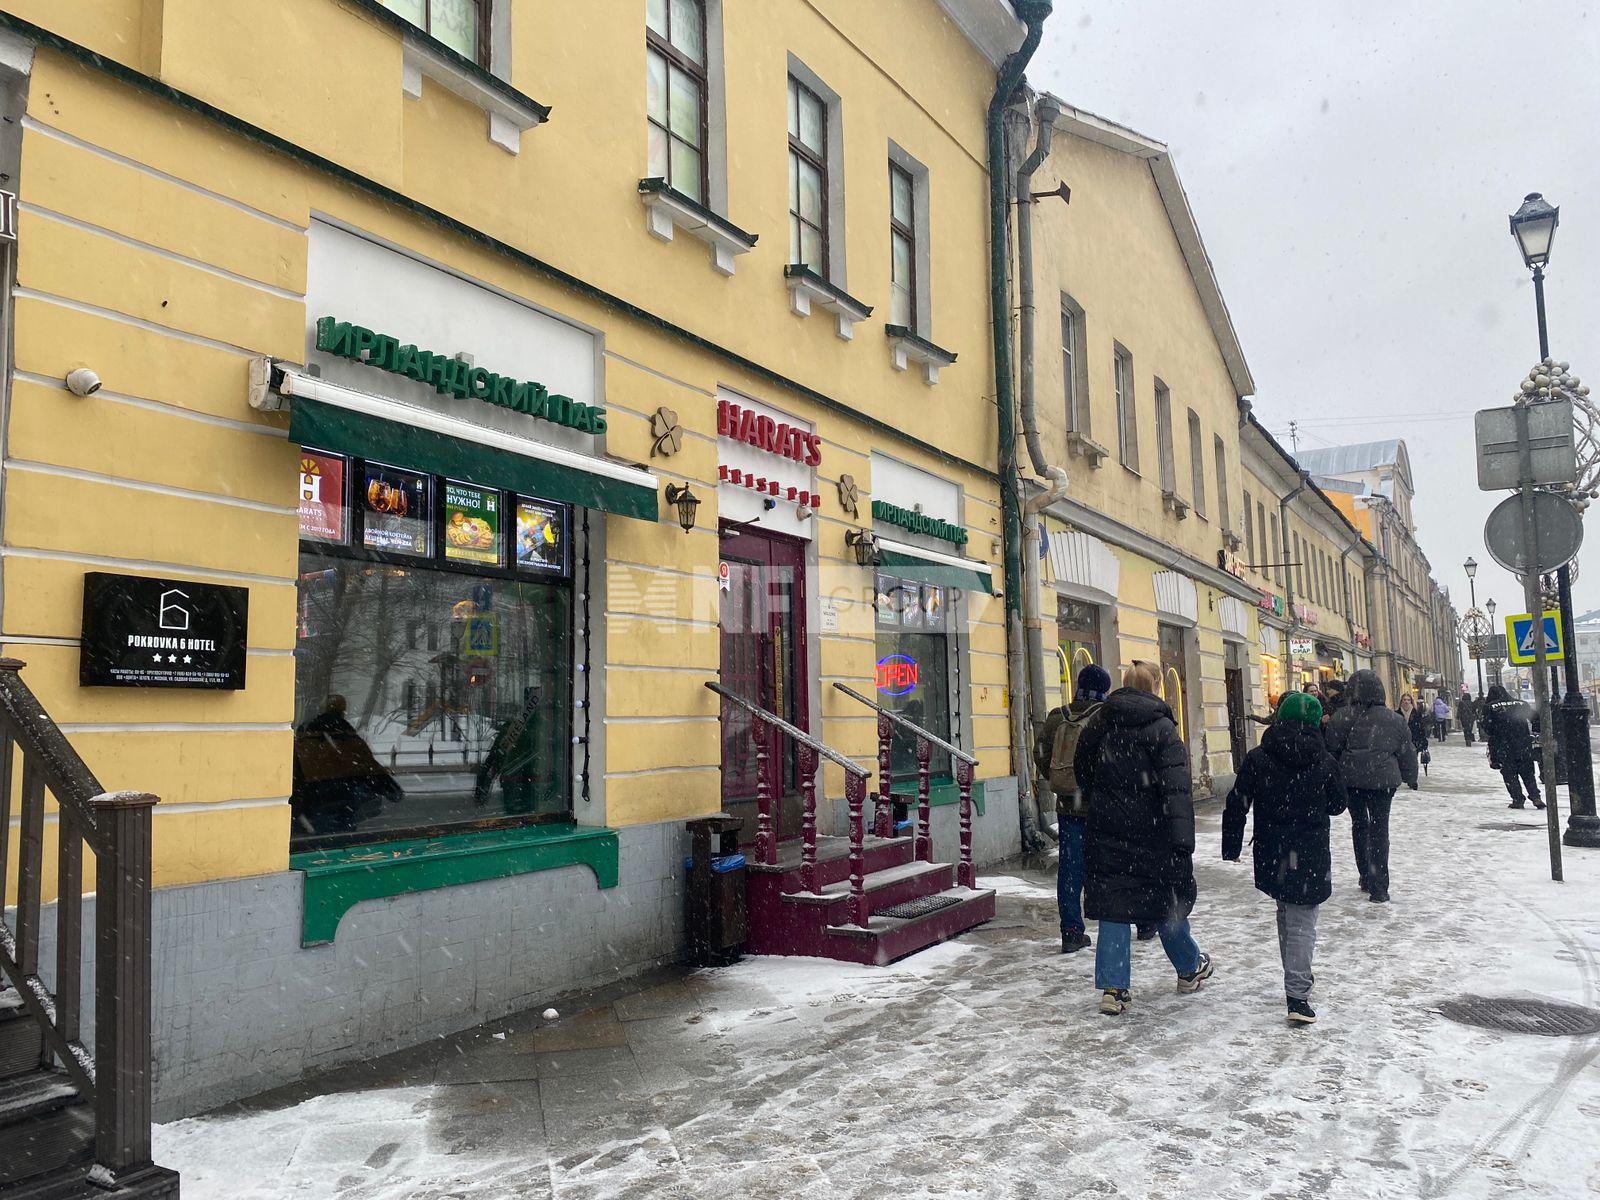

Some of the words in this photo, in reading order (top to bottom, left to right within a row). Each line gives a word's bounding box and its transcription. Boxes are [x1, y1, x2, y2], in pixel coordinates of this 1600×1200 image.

[317, 316, 549, 418] ИРЛАНДСКИЙ
[549, 394, 607, 434] ПАБ
[446, 494, 481, 509] НУЖНО!
[872, 500, 949, 539] ИРЛАНДСКИЙ
[948, 524, 968, 544] ПАБ
[128, 634, 178, 650] POKROVKA
[179, 638, 186, 650] 6
[187, 639, 216, 652] HOTEL
[876, 663, 918, 688] OPEN
